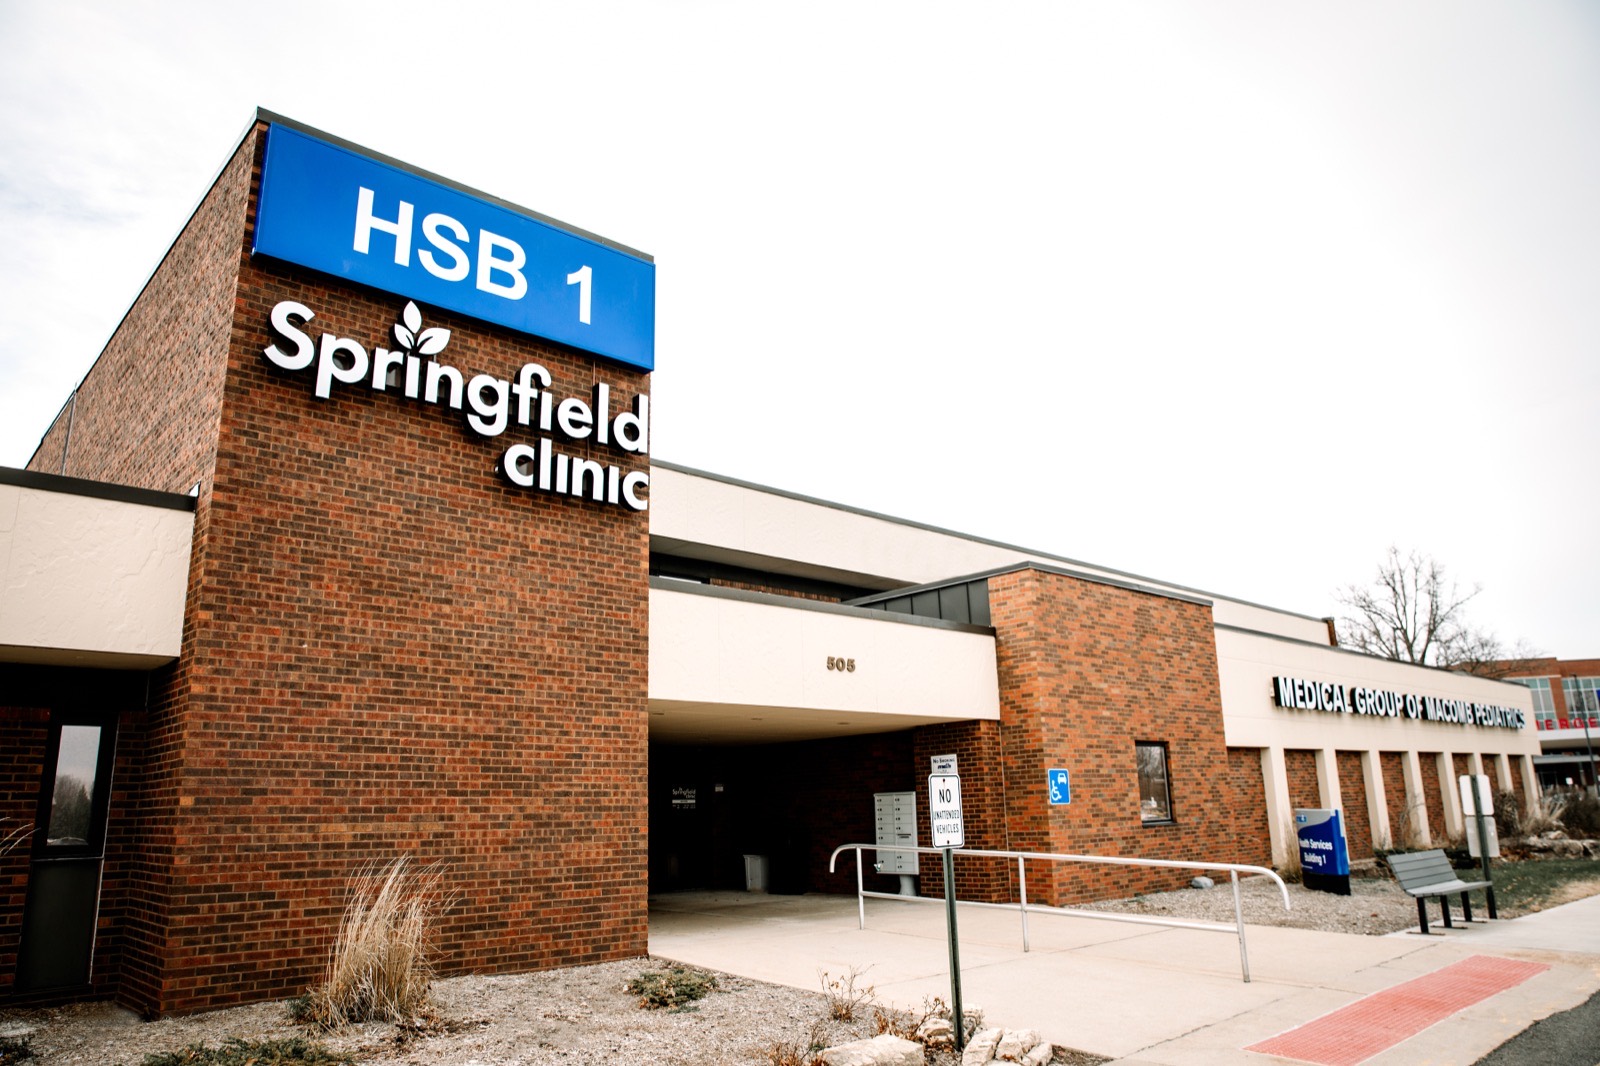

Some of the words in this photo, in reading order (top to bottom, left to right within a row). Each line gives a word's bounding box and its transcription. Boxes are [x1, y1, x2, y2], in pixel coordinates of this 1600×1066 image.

[353, 186, 528, 301] HSB
[566, 265, 593, 325] 1
[263, 300, 649, 455] Springfield
[503, 437, 649, 511] clinic
[826, 655, 856, 673] 505
[1275, 676, 1354, 713] MEDICAL
[1354, 687, 1403, 717] GROUP
[1404, 694, 1423, 719] OF
[1424, 696, 1474, 724] MACOMB
[1473, 703, 1526, 729] PEDIATRICS
[939, 789, 951, 803] NO
[933, 810, 960, 821] UNATTENDED
[936, 823, 959, 834] VEHICLES
[1310, 838, 1333, 850] Services
[1323, 854, 1326, 864] 1
